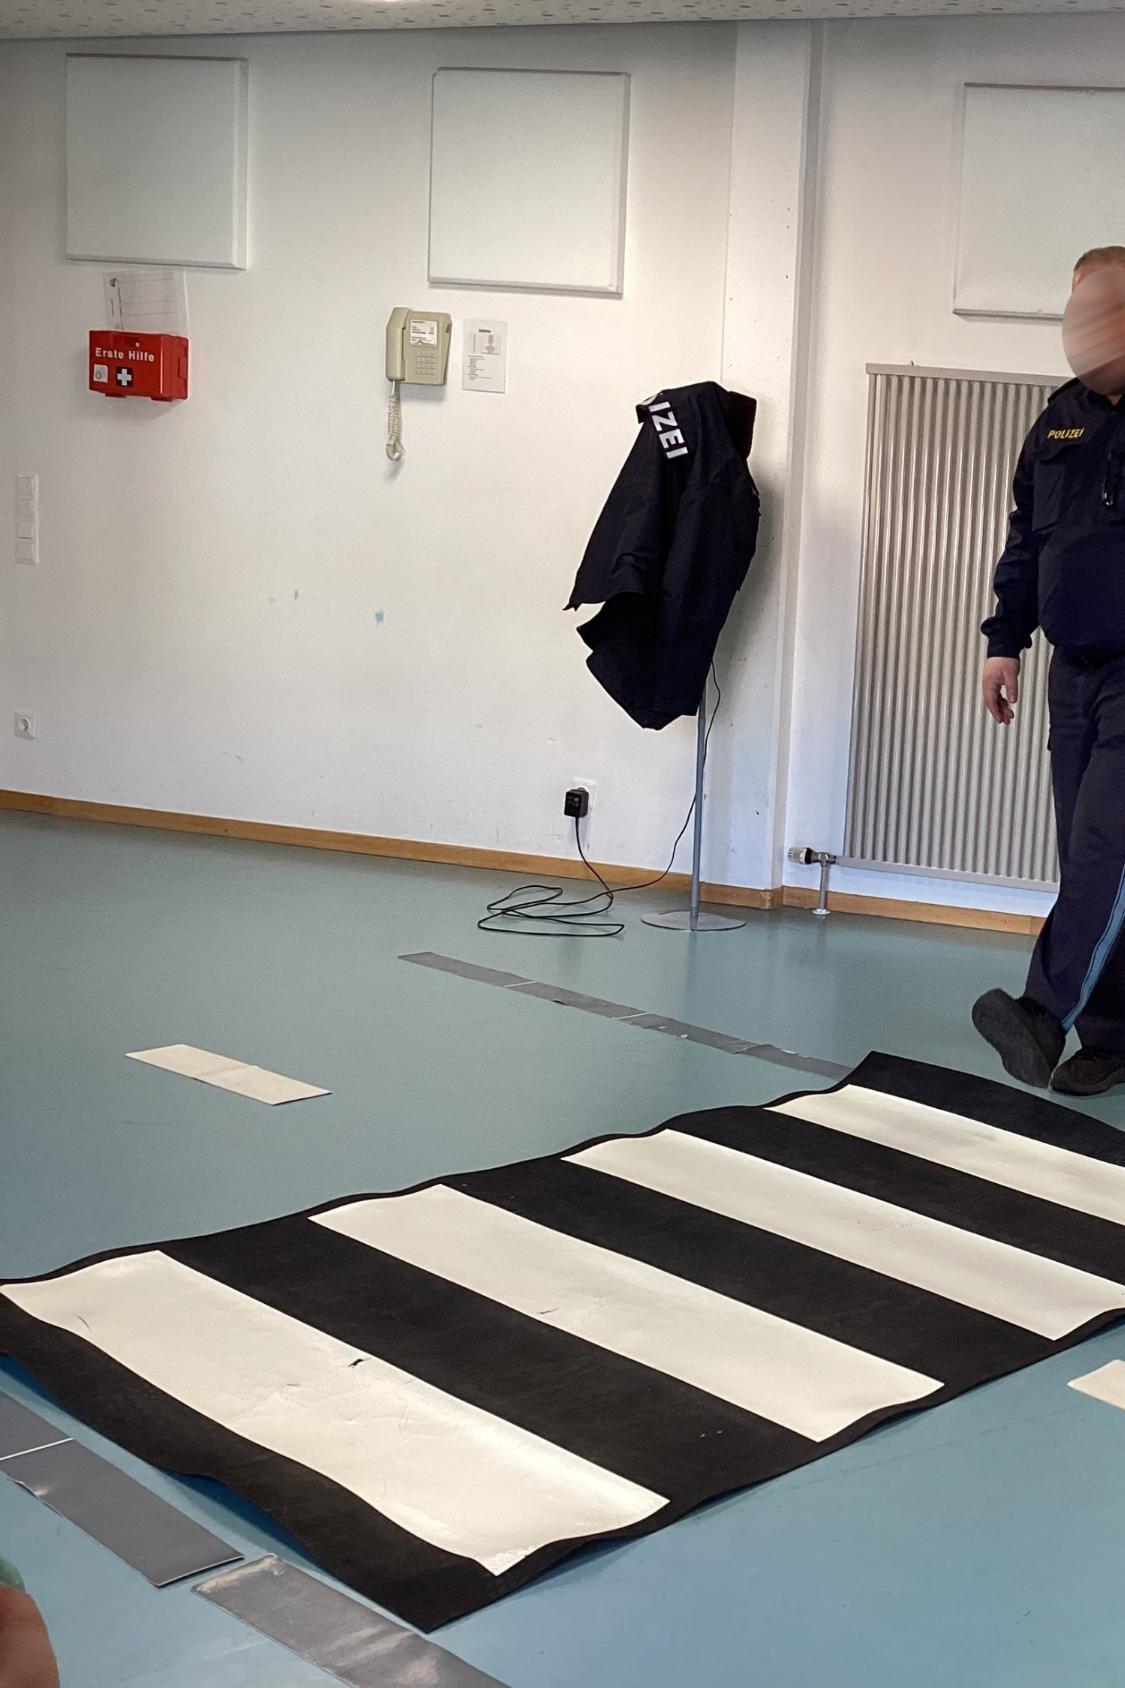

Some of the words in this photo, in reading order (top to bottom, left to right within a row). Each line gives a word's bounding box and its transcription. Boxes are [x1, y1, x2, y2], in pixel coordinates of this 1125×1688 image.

[95, 347, 124, 359] Erste
[128, 350, 155, 362] Hilfe
[1047, 427, 1085, 439] POLIZEI
